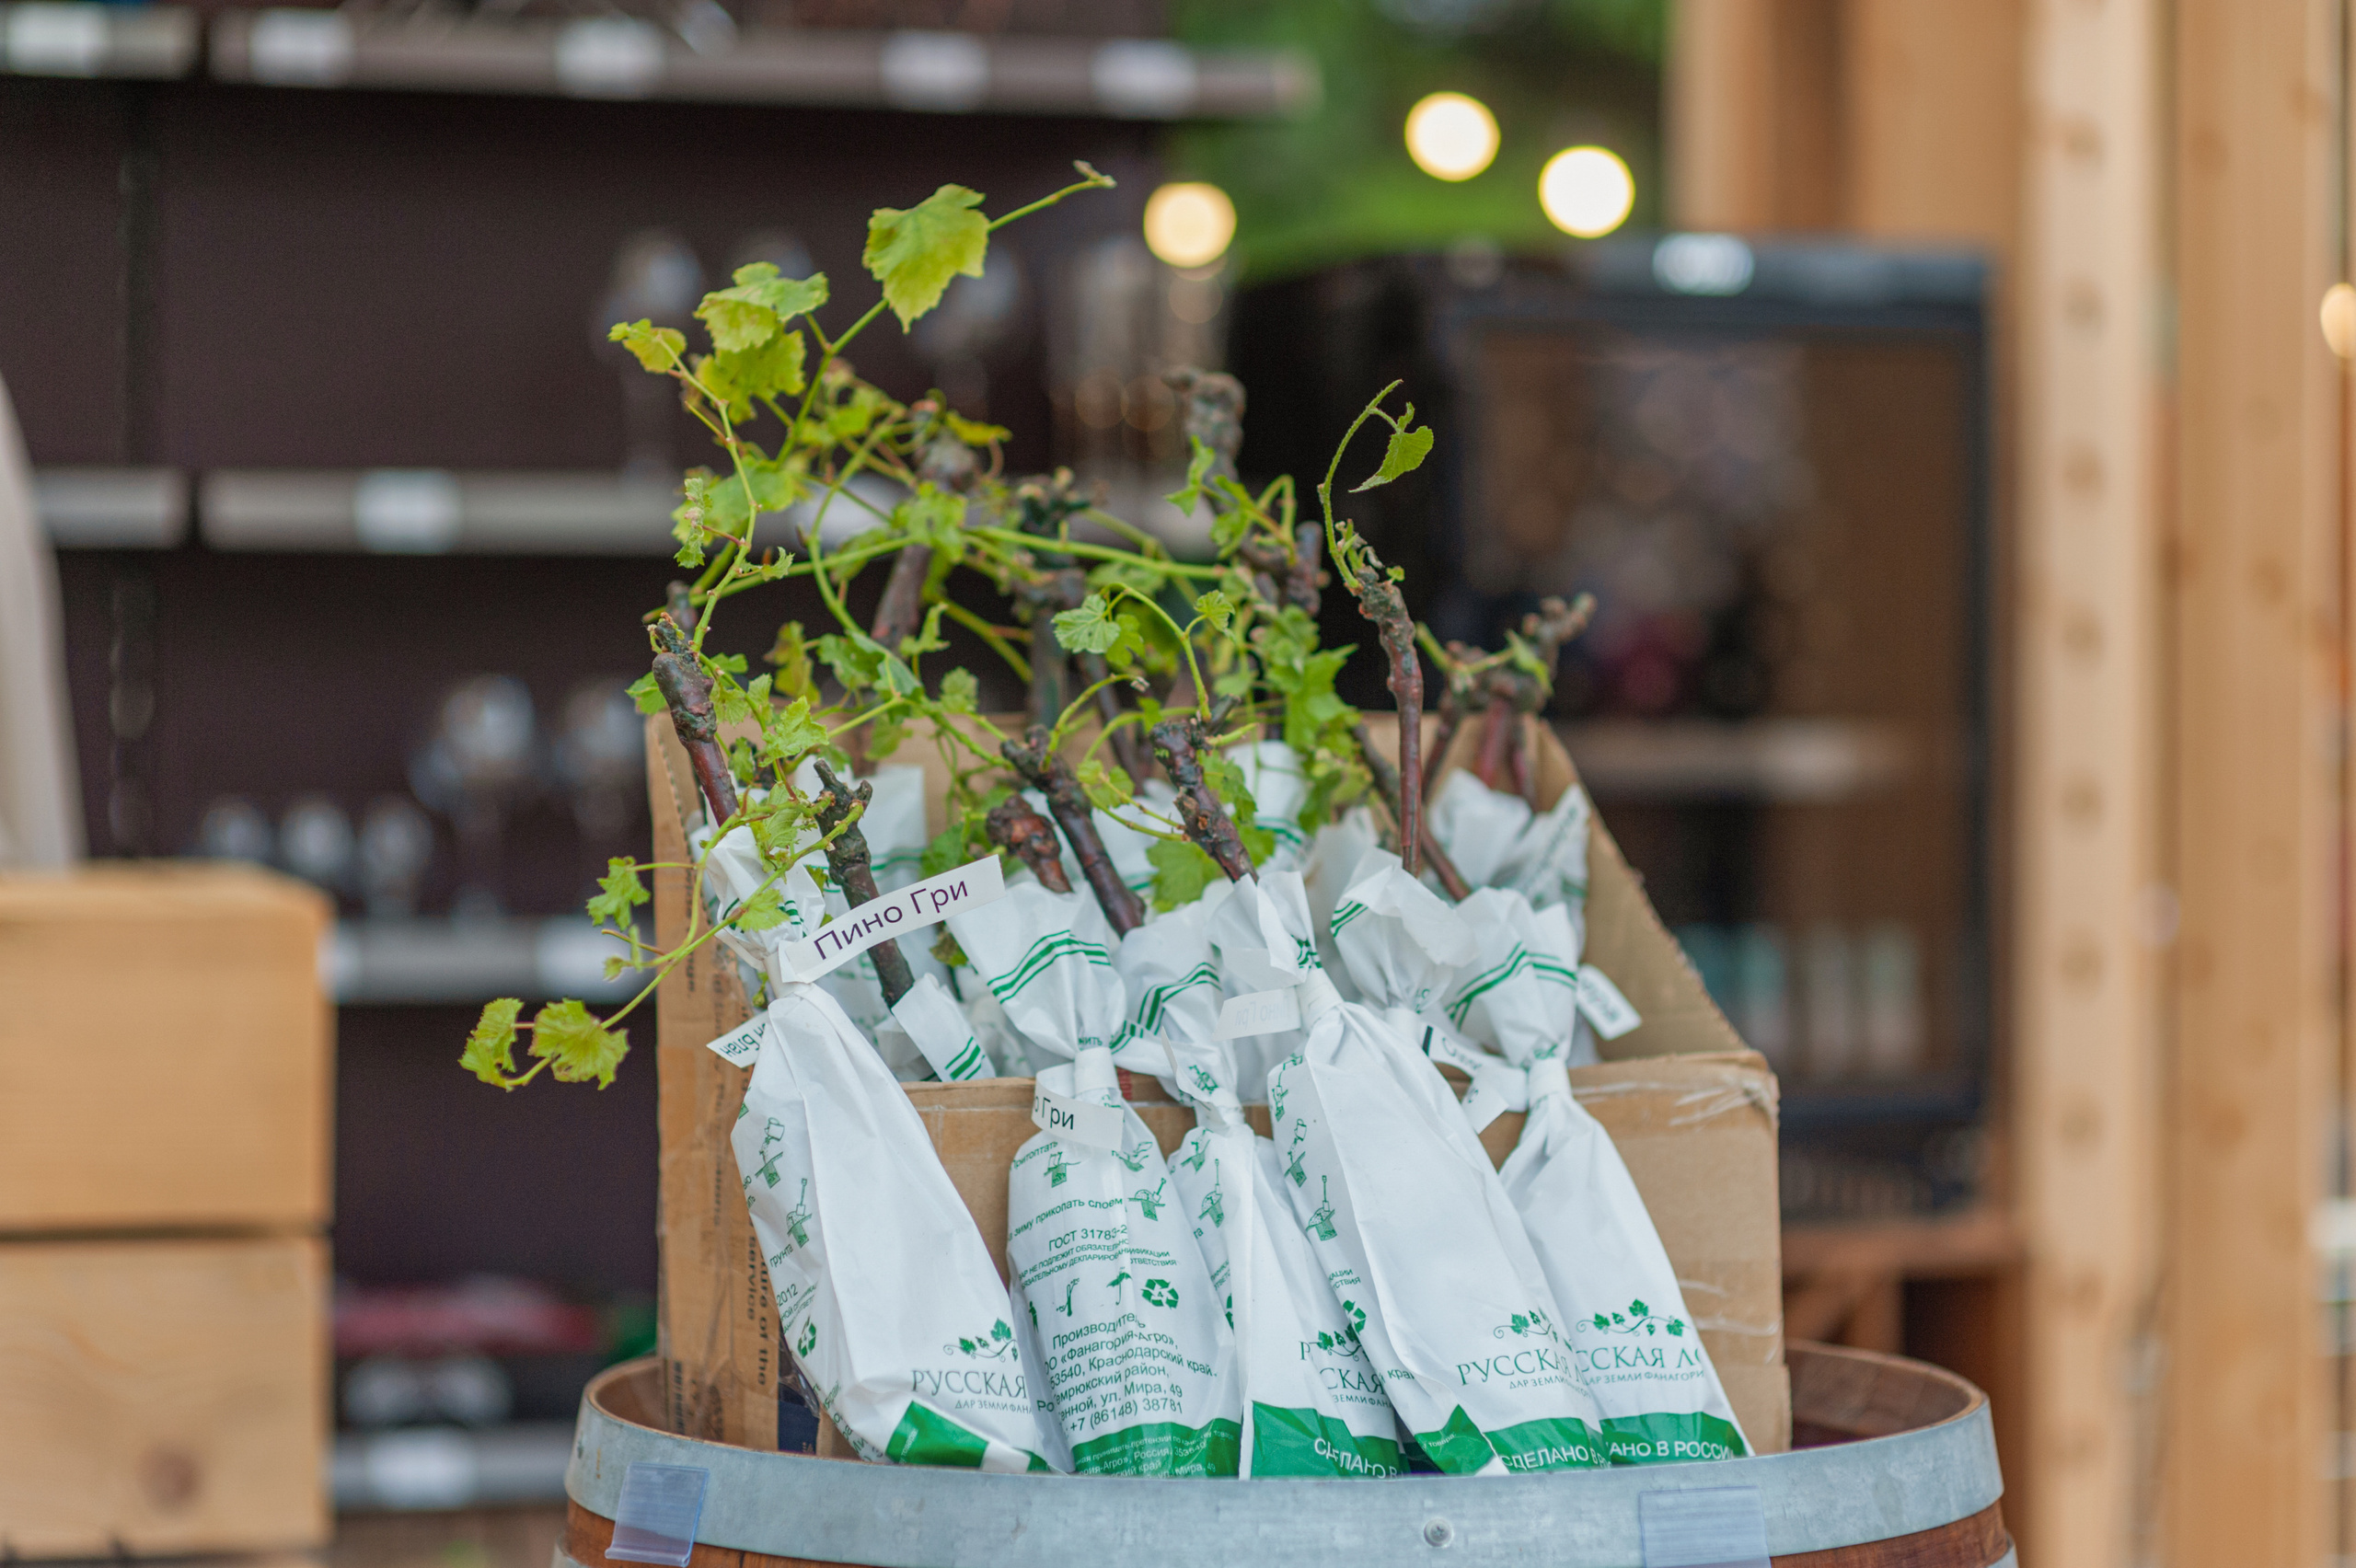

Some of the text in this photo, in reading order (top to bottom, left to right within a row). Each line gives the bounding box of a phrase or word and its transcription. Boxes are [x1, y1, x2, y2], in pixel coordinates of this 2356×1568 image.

[814, 881, 968, 961] Пино Гри
[720, 1032, 760, 1057] Блан
[1042, 1096, 1075, 1131] Гри
[1035, 1199, 1086, 1225] прикопать
[1088, 1197, 1124, 1210] слоем
[1048, 1229, 1078, 1252] ГОСТ
[746, 1235, 758, 1321] service
[1052, 1312, 1147, 1351] Производитеь
[758, 1347, 769, 1386] the
[1089, 1346, 1184, 1372] Краснодарский
[1124, 1363, 1170, 1382] район,
[912, 1369, 1028, 1400] РУССКАЯ
[1509, 1379, 1529, 1389] ДАР
[1604, 1371, 1643, 1385] ЗЕМЛИ
[954, 1400, 976, 1410] ДАР
[978, 1400, 1009, 1412] ЗЕМЛИ
[1058, 1380, 1183, 1422] енной, ул. Мира, 49
[1090, 1399, 1138, 1430] (86148)
[1142, 1397, 1183, 1414] 38781
[1498, 1446, 1590, 1470] СДЕЛАНО
[1657, 1440, 1669, 1458] В
